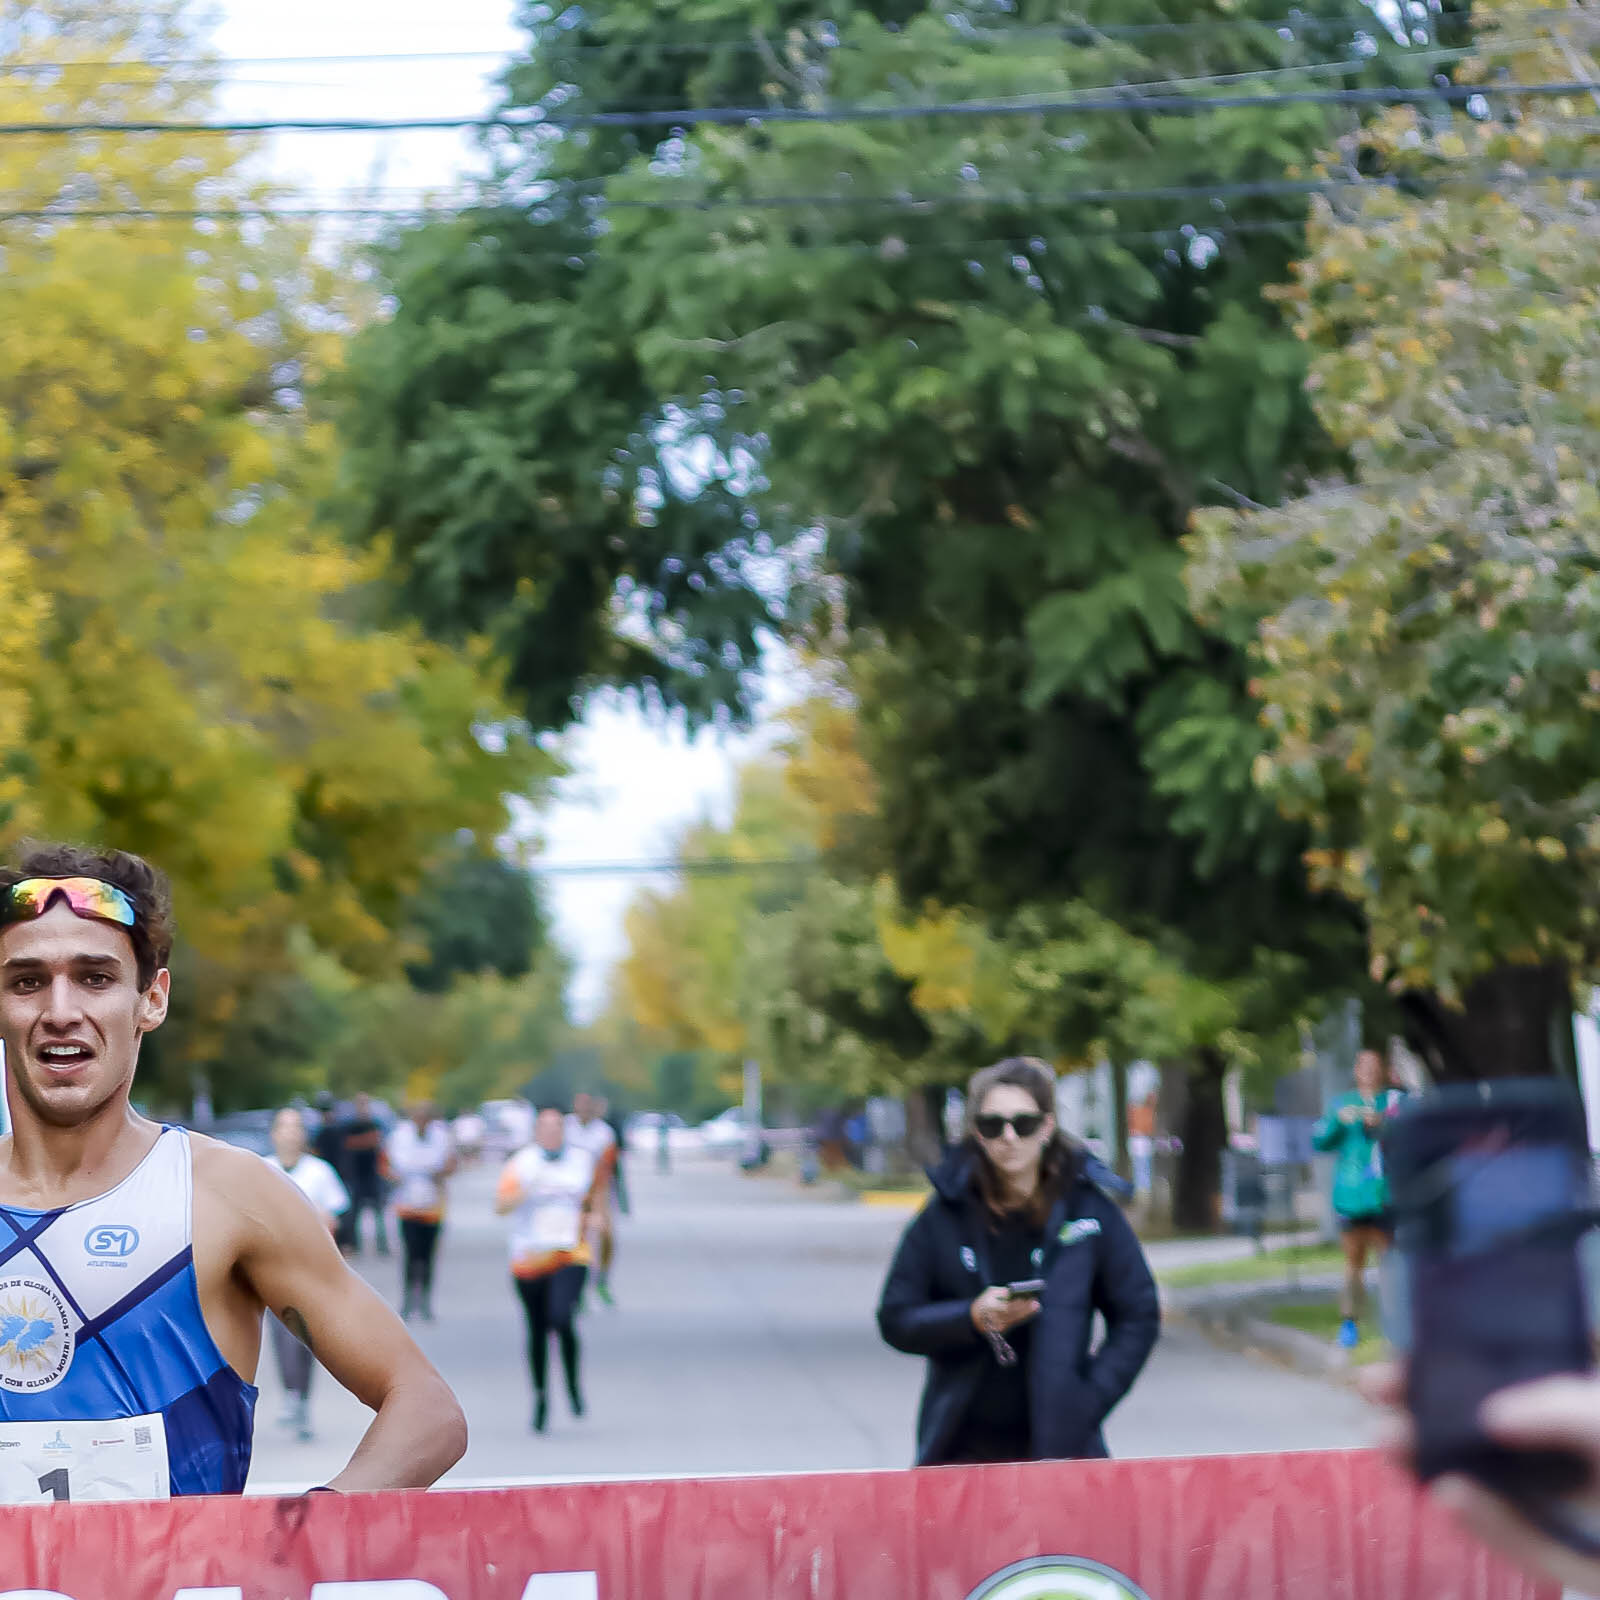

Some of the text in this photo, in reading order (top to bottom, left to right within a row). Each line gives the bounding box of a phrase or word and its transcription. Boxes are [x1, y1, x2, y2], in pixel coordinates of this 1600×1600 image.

[11, 1279, 22, 1287] DE
[23, 1280, 52, 1297] GLORIA
[4, 1377, 23, 1387] CON
[26, 1372, 60, 1388] GLORIA
